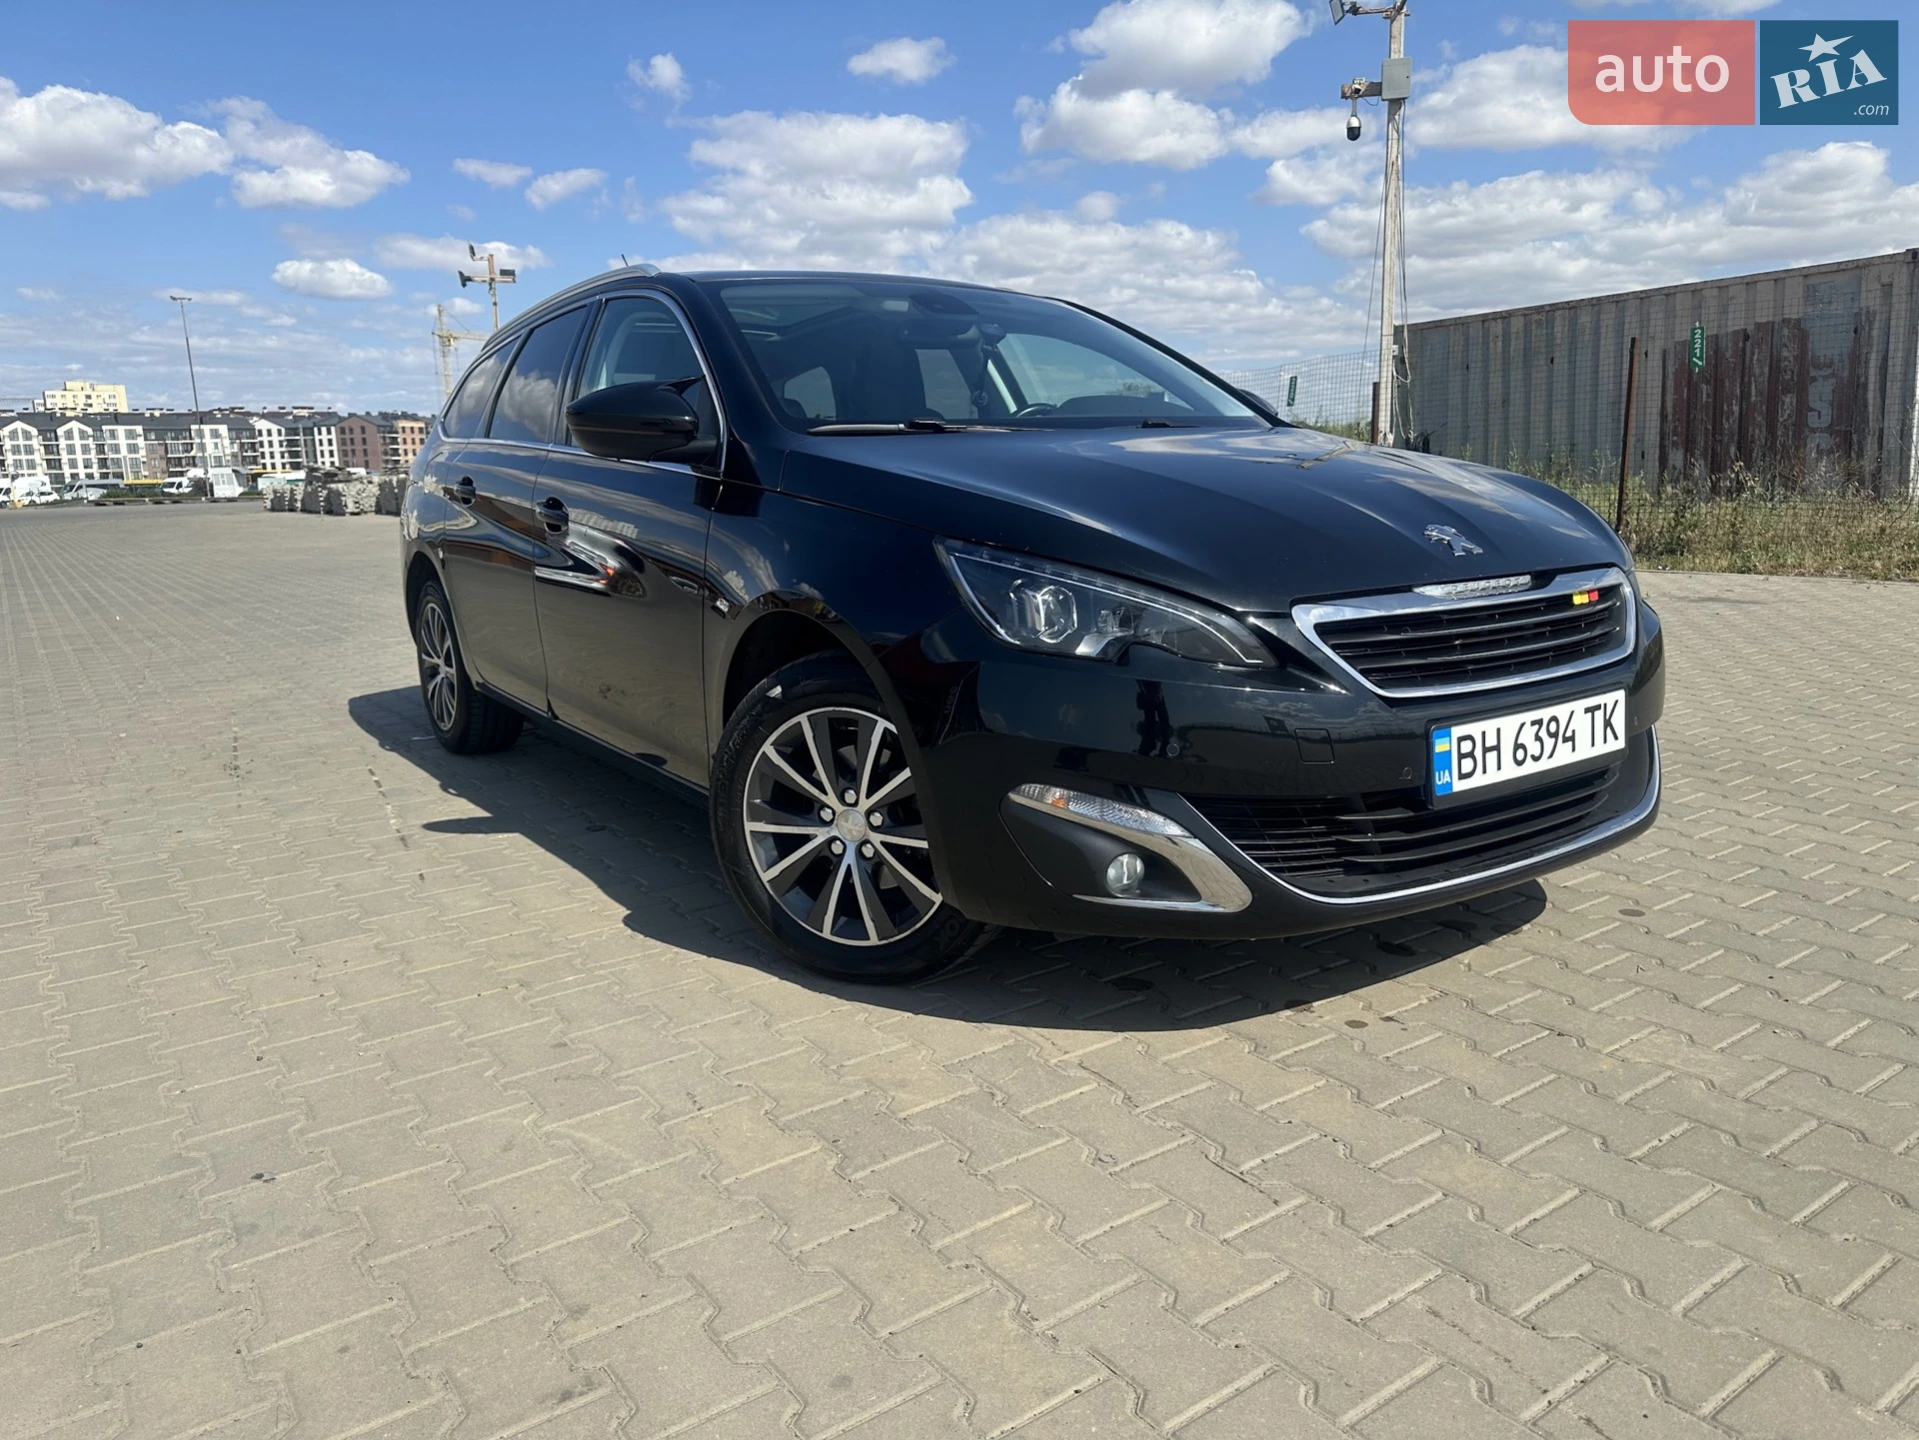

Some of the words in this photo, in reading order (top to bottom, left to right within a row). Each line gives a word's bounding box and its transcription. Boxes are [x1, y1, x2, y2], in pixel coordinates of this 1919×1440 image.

[1457, 727, 1502, 781] BH
[1512, 710, 1576, 767] 6394
[1584, 699, 1619, 748] TK
[1435, 770, 1451, 785] UA
